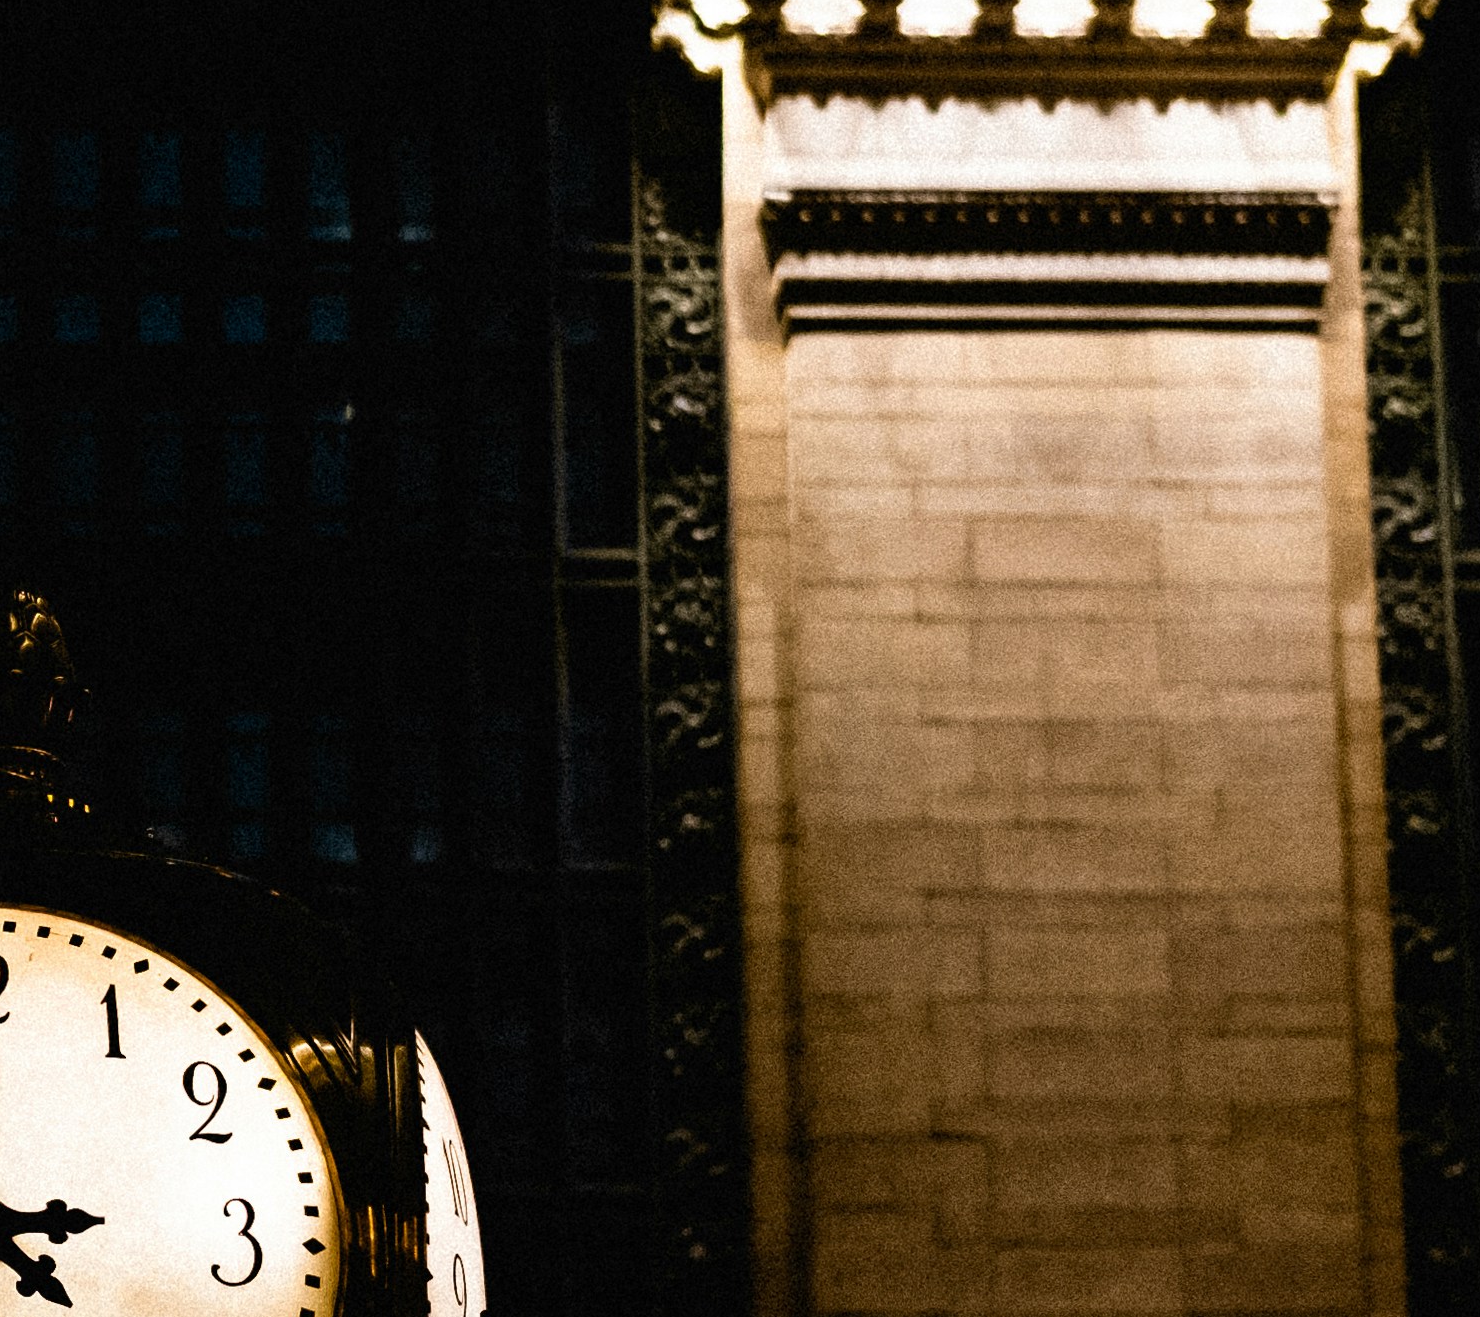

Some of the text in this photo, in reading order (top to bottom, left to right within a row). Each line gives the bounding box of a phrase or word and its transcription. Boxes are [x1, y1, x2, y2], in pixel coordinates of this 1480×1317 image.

[100, 983, 127, 1060] 1
[181, 1060, 234, 1145] 2
[210, 1197, 264, 1288] 3
